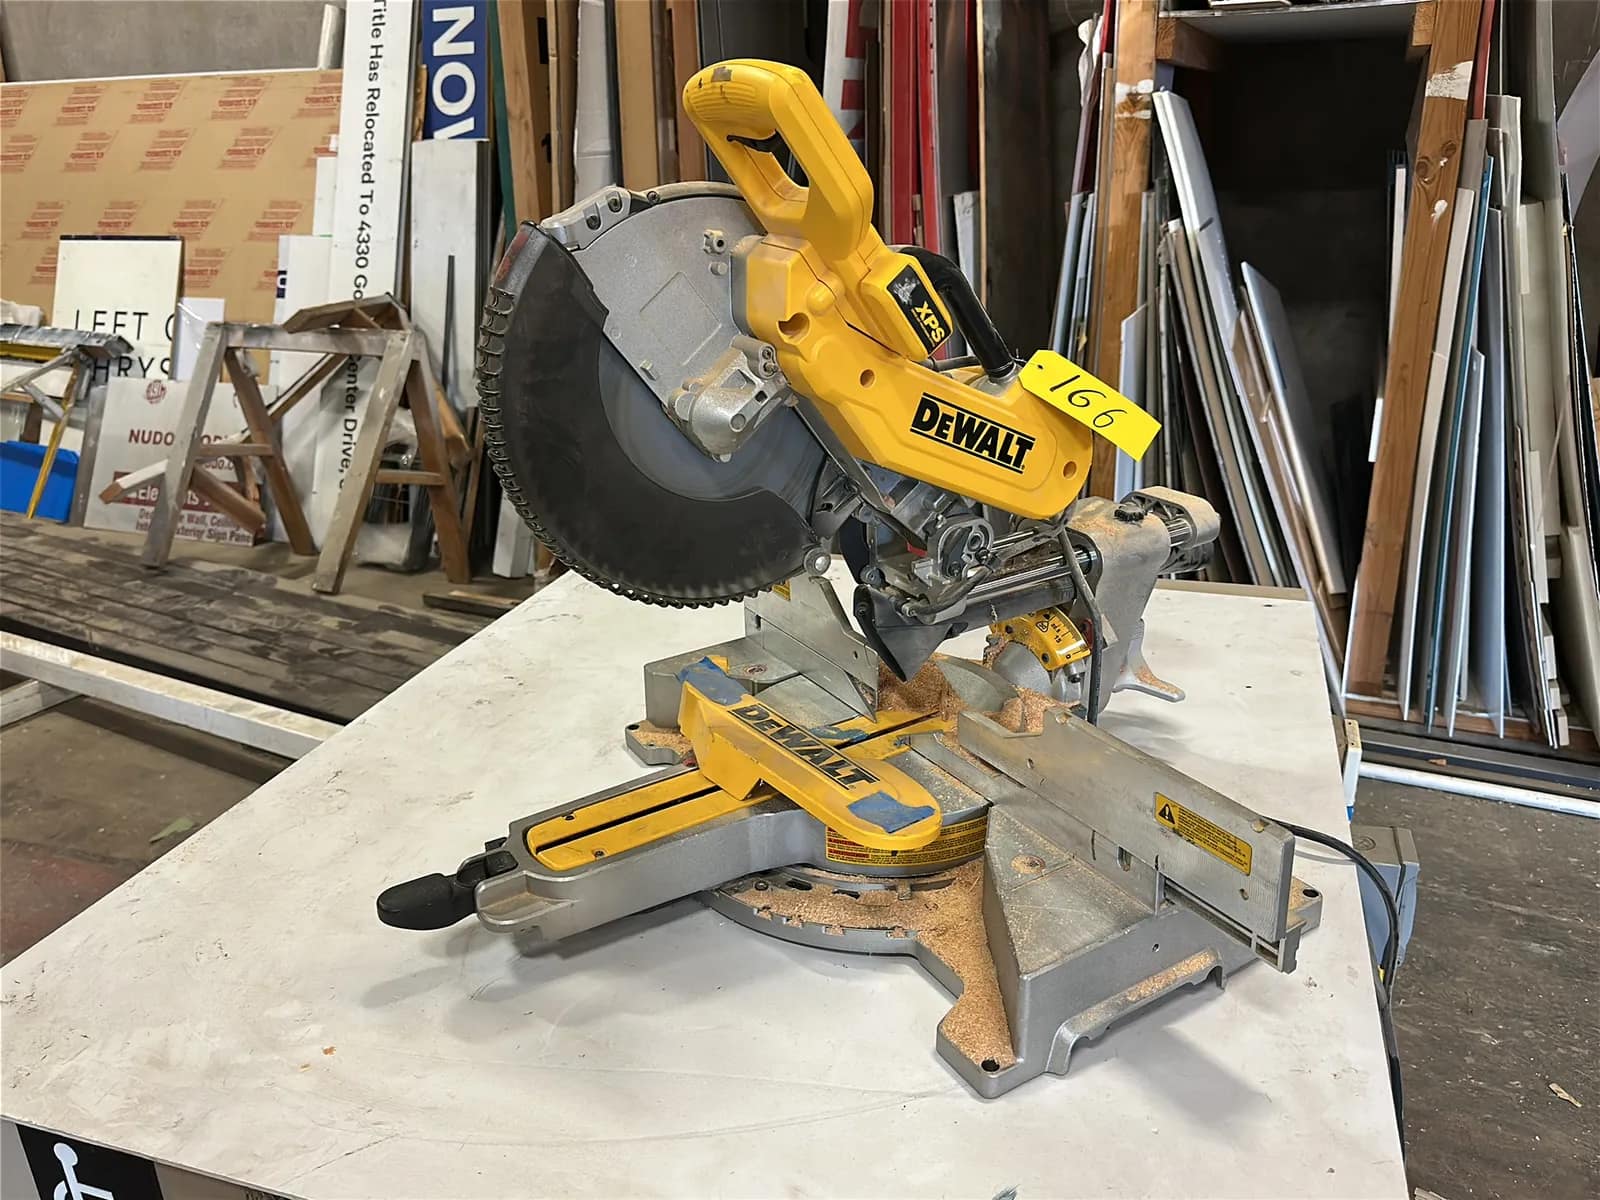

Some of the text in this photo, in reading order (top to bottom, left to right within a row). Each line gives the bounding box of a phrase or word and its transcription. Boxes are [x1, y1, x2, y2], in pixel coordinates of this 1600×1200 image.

[367, 44, 384, 82] Has
[360, 87, 381, 184] Relocated
[359, 189, 374, 215] To
[355, 220, 372, 269] 4330
[915, 302, 946, 345] XPS
[1050, 374, 1128, 428] 166
[128, 428, 175, 447] NUDO
